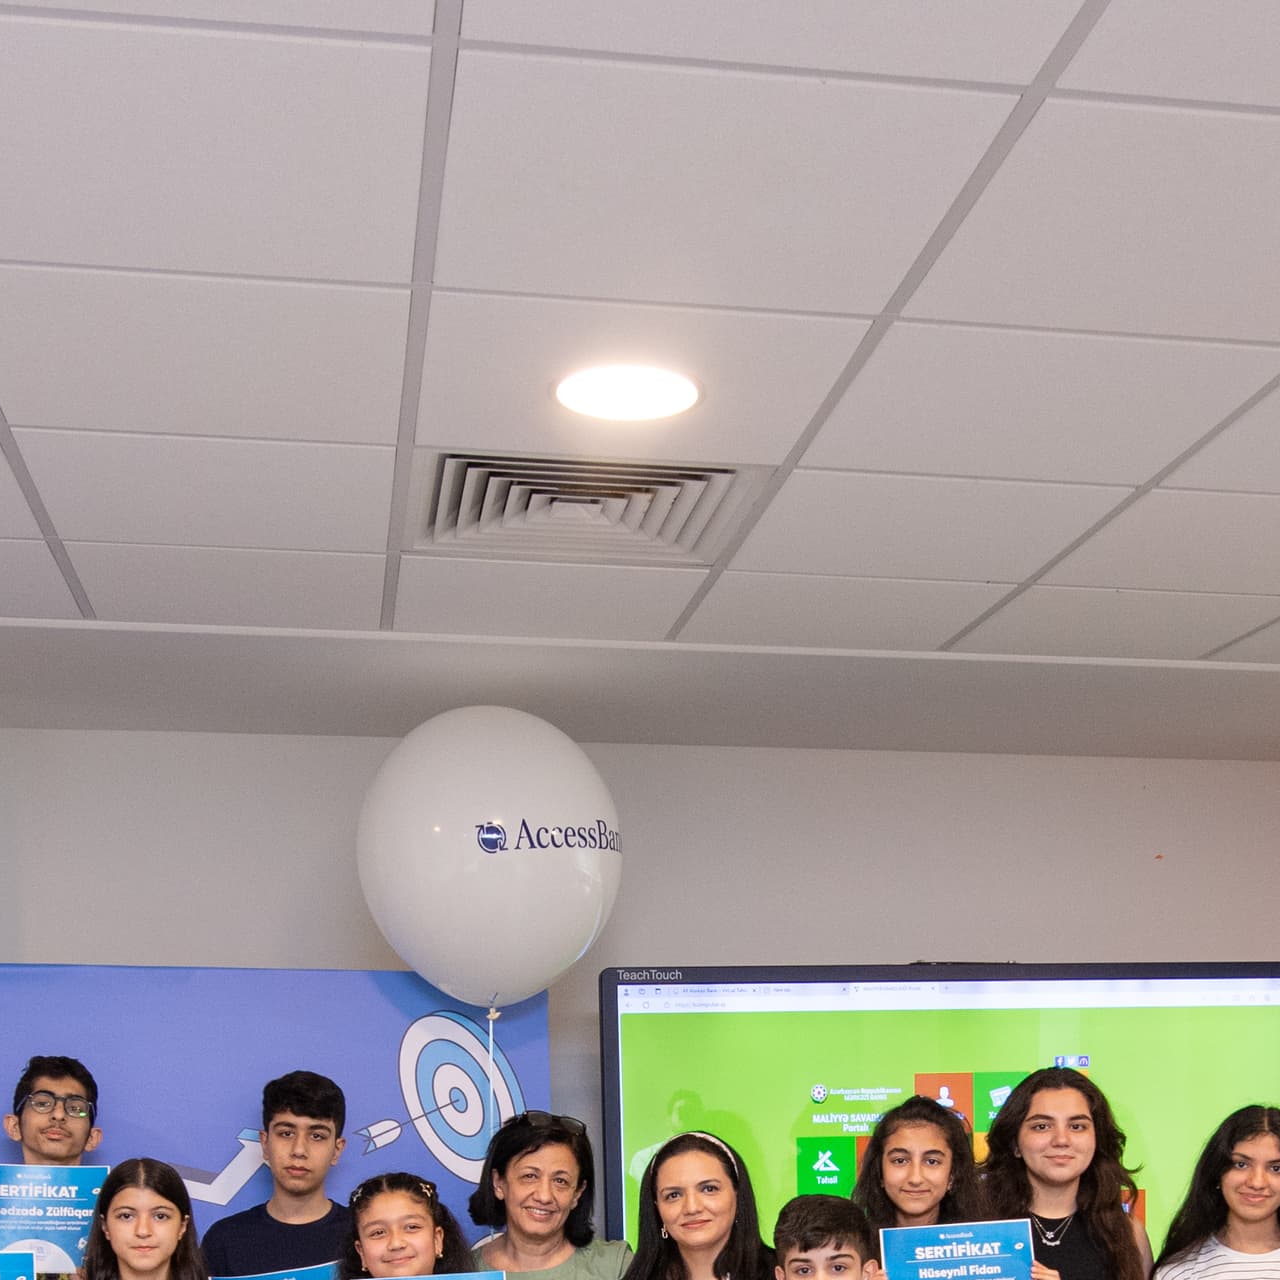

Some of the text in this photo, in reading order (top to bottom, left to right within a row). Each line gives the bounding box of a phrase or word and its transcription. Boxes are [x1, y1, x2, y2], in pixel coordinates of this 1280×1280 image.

[514, 818, 623, 853] AccessBan
[616, 969, 682, 980] TeachTouch
[816, 1176, 838, 1185] Təhsil
[915, 1241, 1001, 1260] SERTİFİKAT
[919, 1264, 1001, 1279] Hüseynli Fidan
